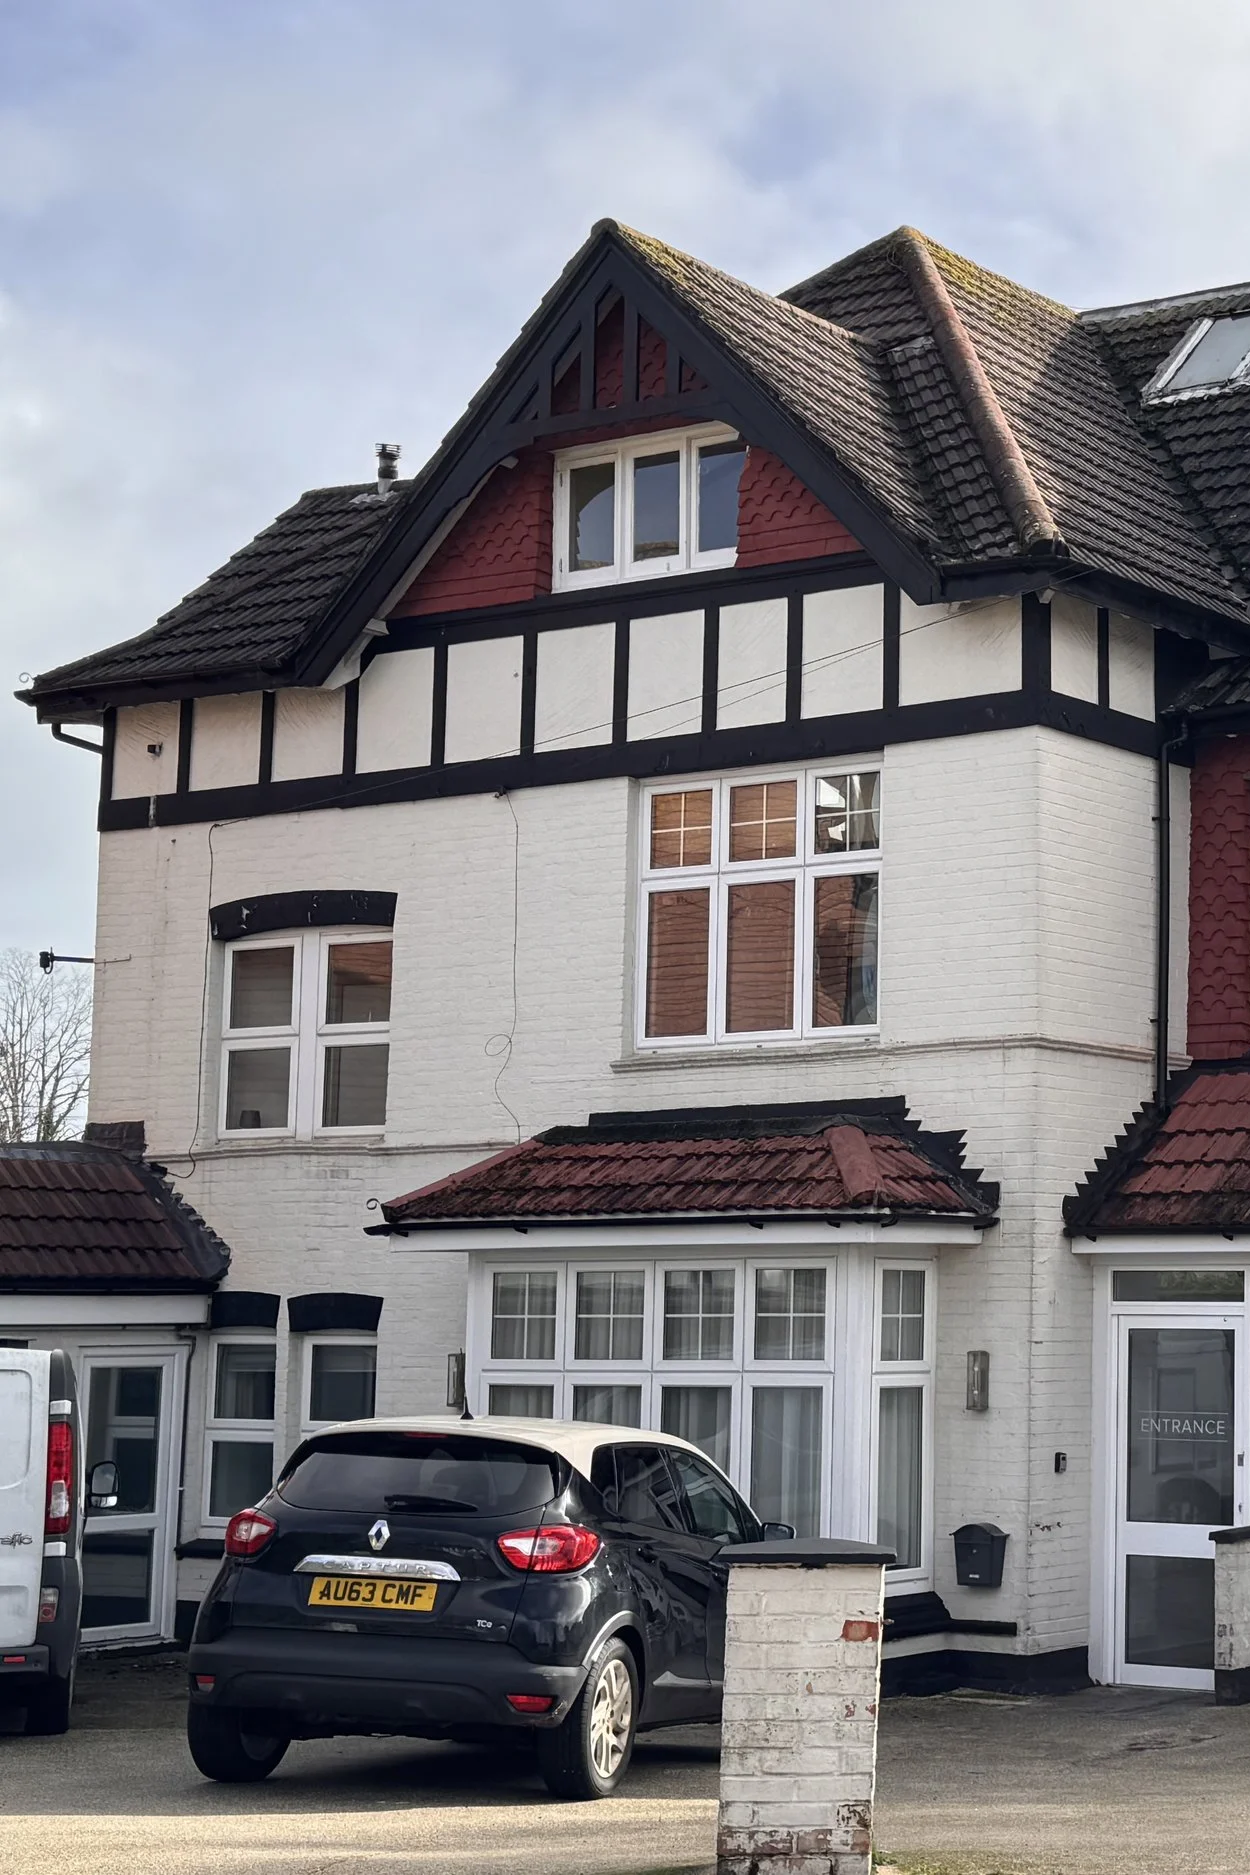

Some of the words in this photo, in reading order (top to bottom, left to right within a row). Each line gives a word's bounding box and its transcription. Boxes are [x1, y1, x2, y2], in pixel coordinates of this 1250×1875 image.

[1140, 1418, 1225, 1435] ENTRANCE
[323, 1560, 427, 1575] CAPTUR
[319, 1580, 377, 1602] AU63
[380, 1583, 427, 1605] CMF
